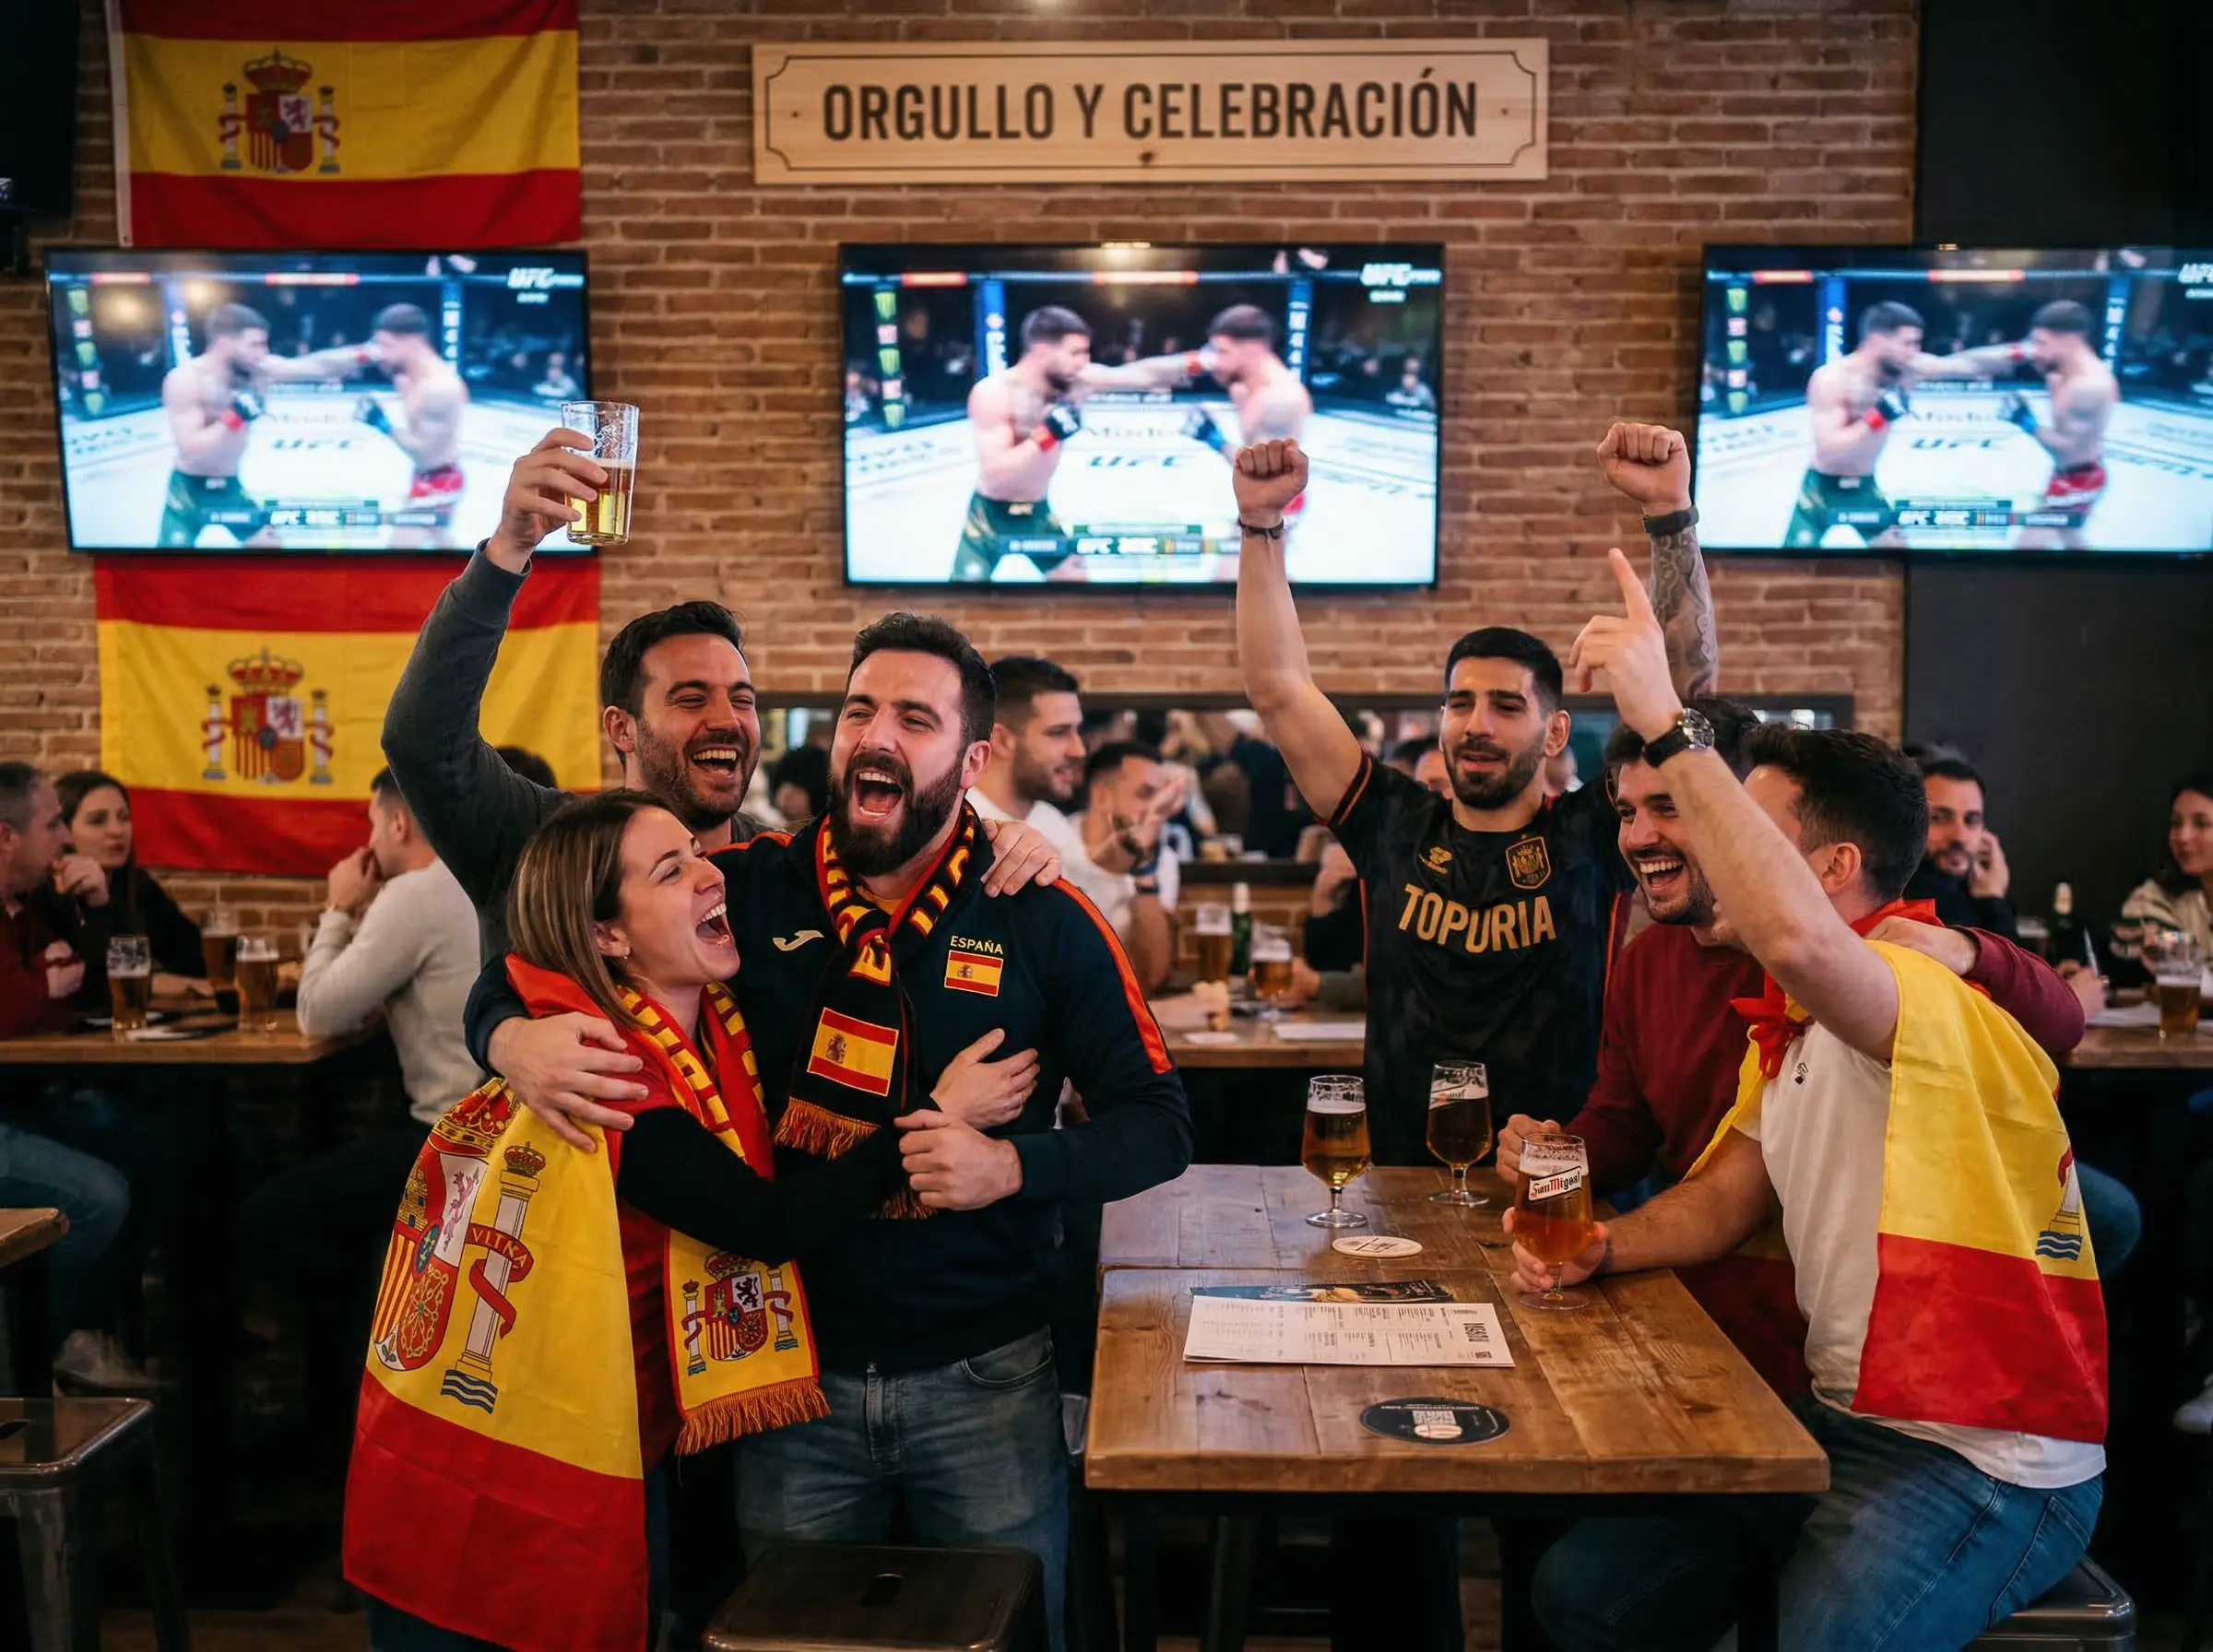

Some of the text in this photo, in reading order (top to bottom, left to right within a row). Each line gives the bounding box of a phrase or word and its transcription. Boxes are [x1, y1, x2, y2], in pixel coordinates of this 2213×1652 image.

[823, 66, 1477, 141] ORGULLO Y CELEBRACIÓN
[950, 935, 1004, 955] ESPAÑA
[1398, 883, 1557, 954] TOPURIA
